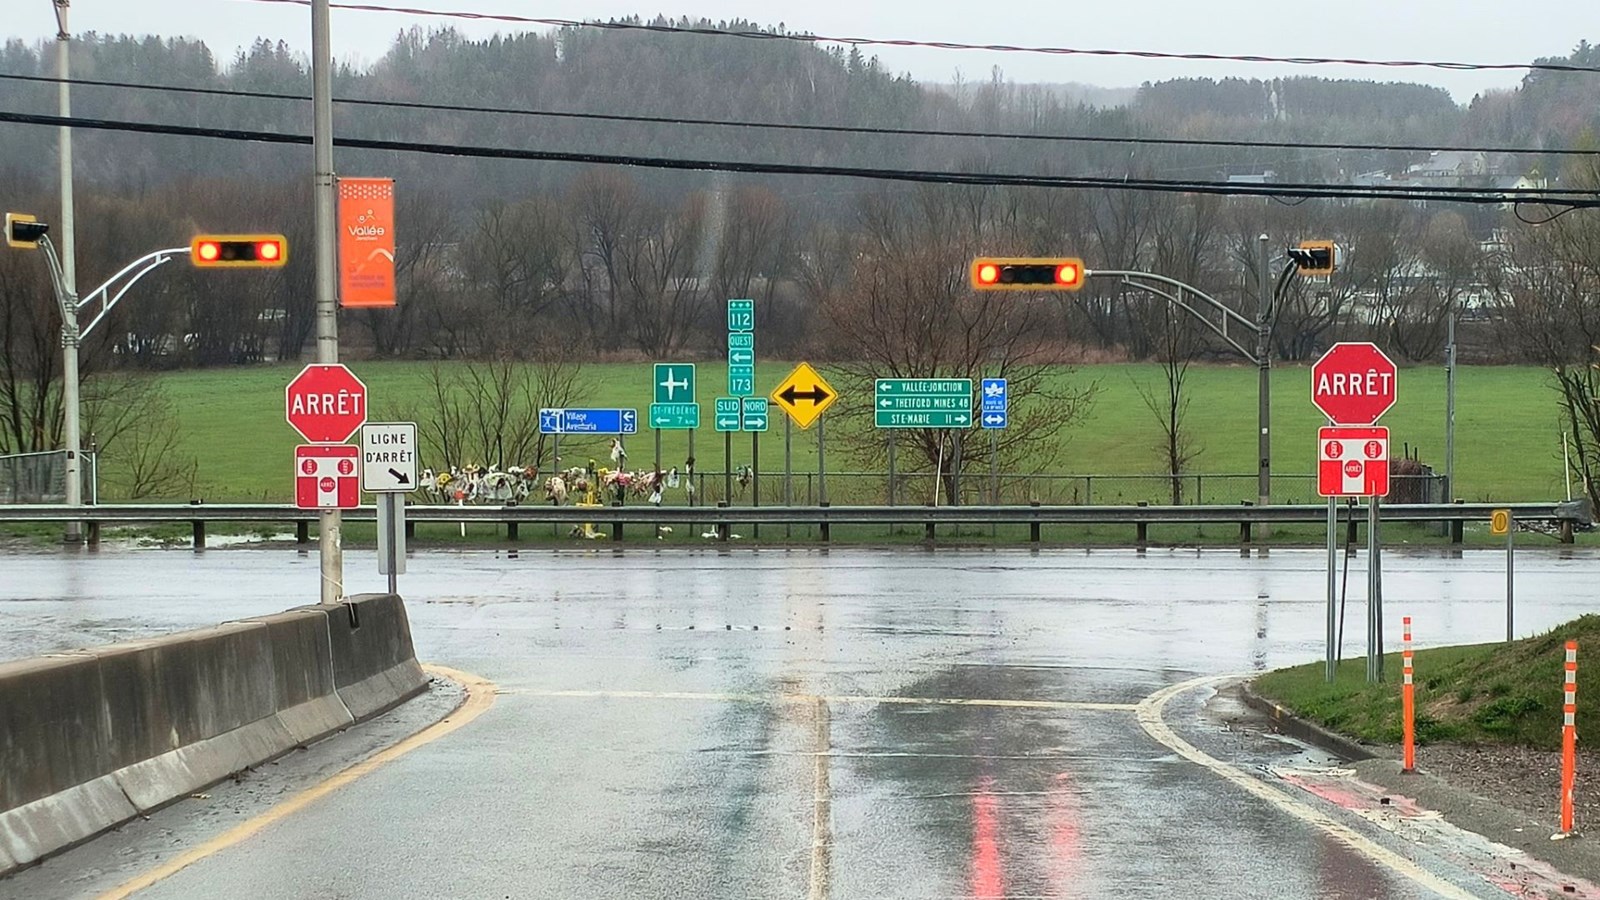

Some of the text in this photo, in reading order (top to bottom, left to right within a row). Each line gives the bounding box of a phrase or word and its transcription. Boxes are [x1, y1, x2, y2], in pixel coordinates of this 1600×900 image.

[348, 224, 385, 236] Vallée
[731, 313, 750, 326] 112
[730, 335, 751, 346] OUEST
[732, 378, 751, 391] 173
[901, 382, 963, 393] VALLÉE-JONCTION
[1316, 369, 1392, 396] ARRÊT
[291, 389, 362, 415] ARRÊT
[717, 401, 739, 412] SUD
[744, 401, 766, 412] NORD
[895, 398, 931, 408] THETFORD
[934, 398, 956, 408] MINES
[653, 405, 696, 415] ST-FRÉDÉRIC
[677, 416, 683, 424] 7
[891, 414, 930, 424] STE-MARIE
[623, 423, 634, 432] 22
[371, 433, 407, 445] LIGNE
[366, 450, 413, 463] D'ARRÊT
